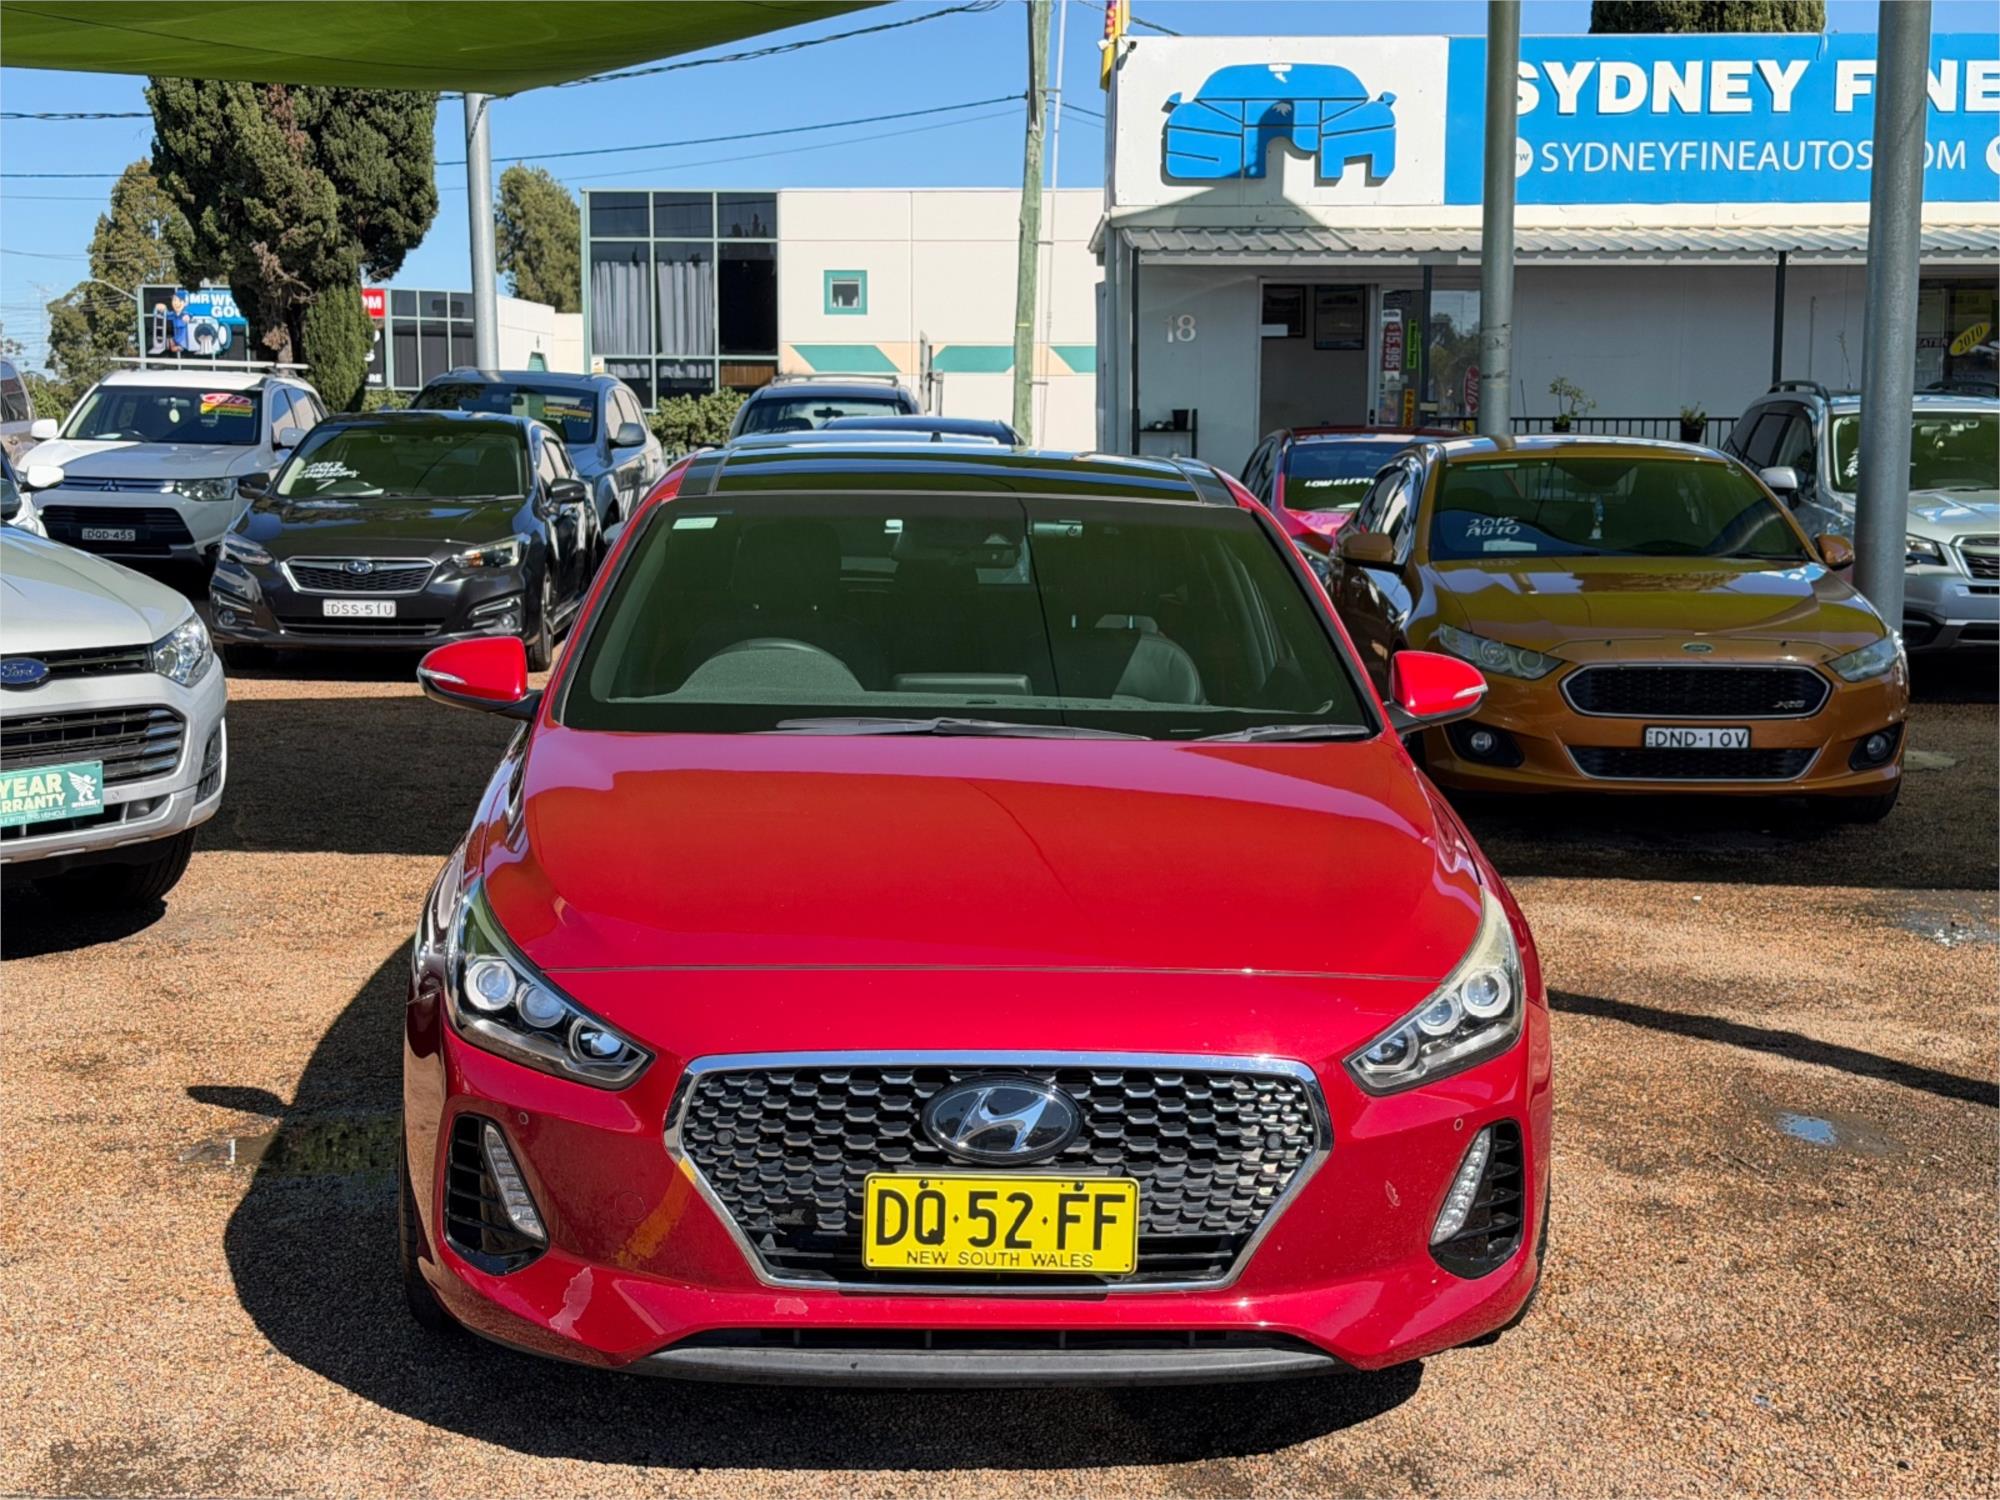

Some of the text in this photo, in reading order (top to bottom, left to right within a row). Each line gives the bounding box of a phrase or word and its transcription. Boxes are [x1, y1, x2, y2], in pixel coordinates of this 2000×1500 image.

[1517, 59, 2000, 115] SYDNEY FNE
[1541, 140, 1966, 172] SYDNEYFINEAUTOSM
[1164, 314, 1196, 343] 18
[1, 663, 35, 678] Ford
[0, 774, 62, 800] YEAR
[907, 1251, 1093, 1268] NEW SOUTH WALES
